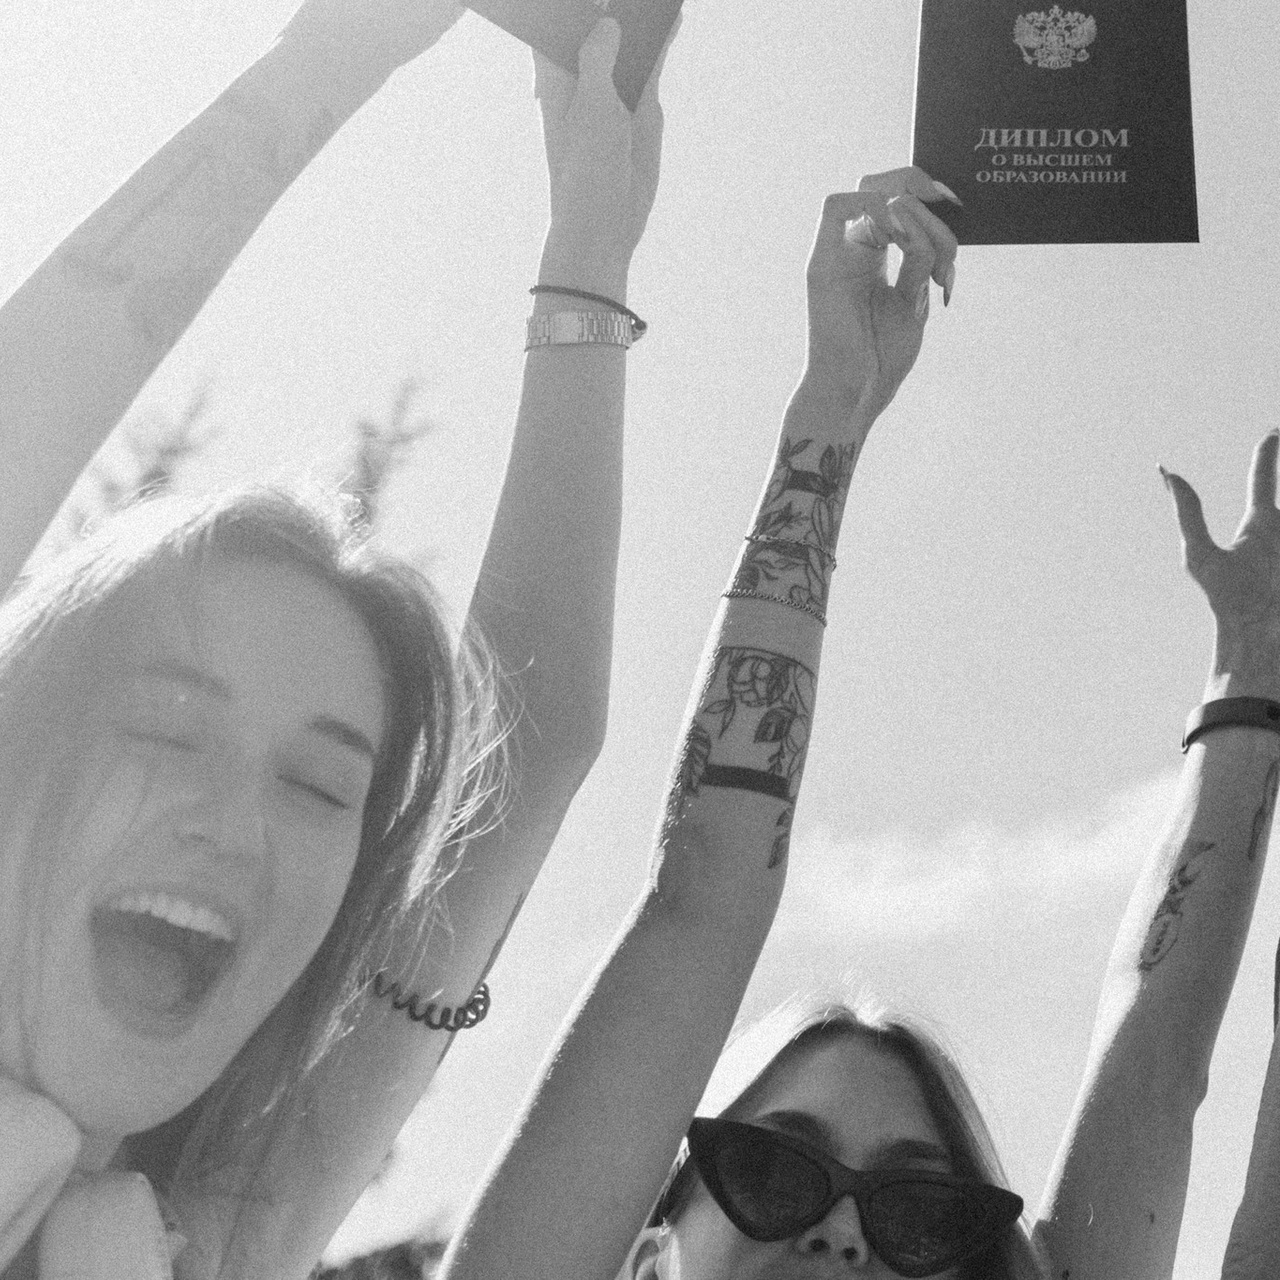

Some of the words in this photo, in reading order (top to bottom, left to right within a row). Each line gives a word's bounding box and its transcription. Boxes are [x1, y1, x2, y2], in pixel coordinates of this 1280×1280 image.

[975, 128, 1130, 151] ДИПЛОМ
[991, 154, 1007, 166] О
[1013, 154, 1112, 166] ВЫСШЕМ
[975, 170, 1127, 183] ОБРАЗОВАНИИ
